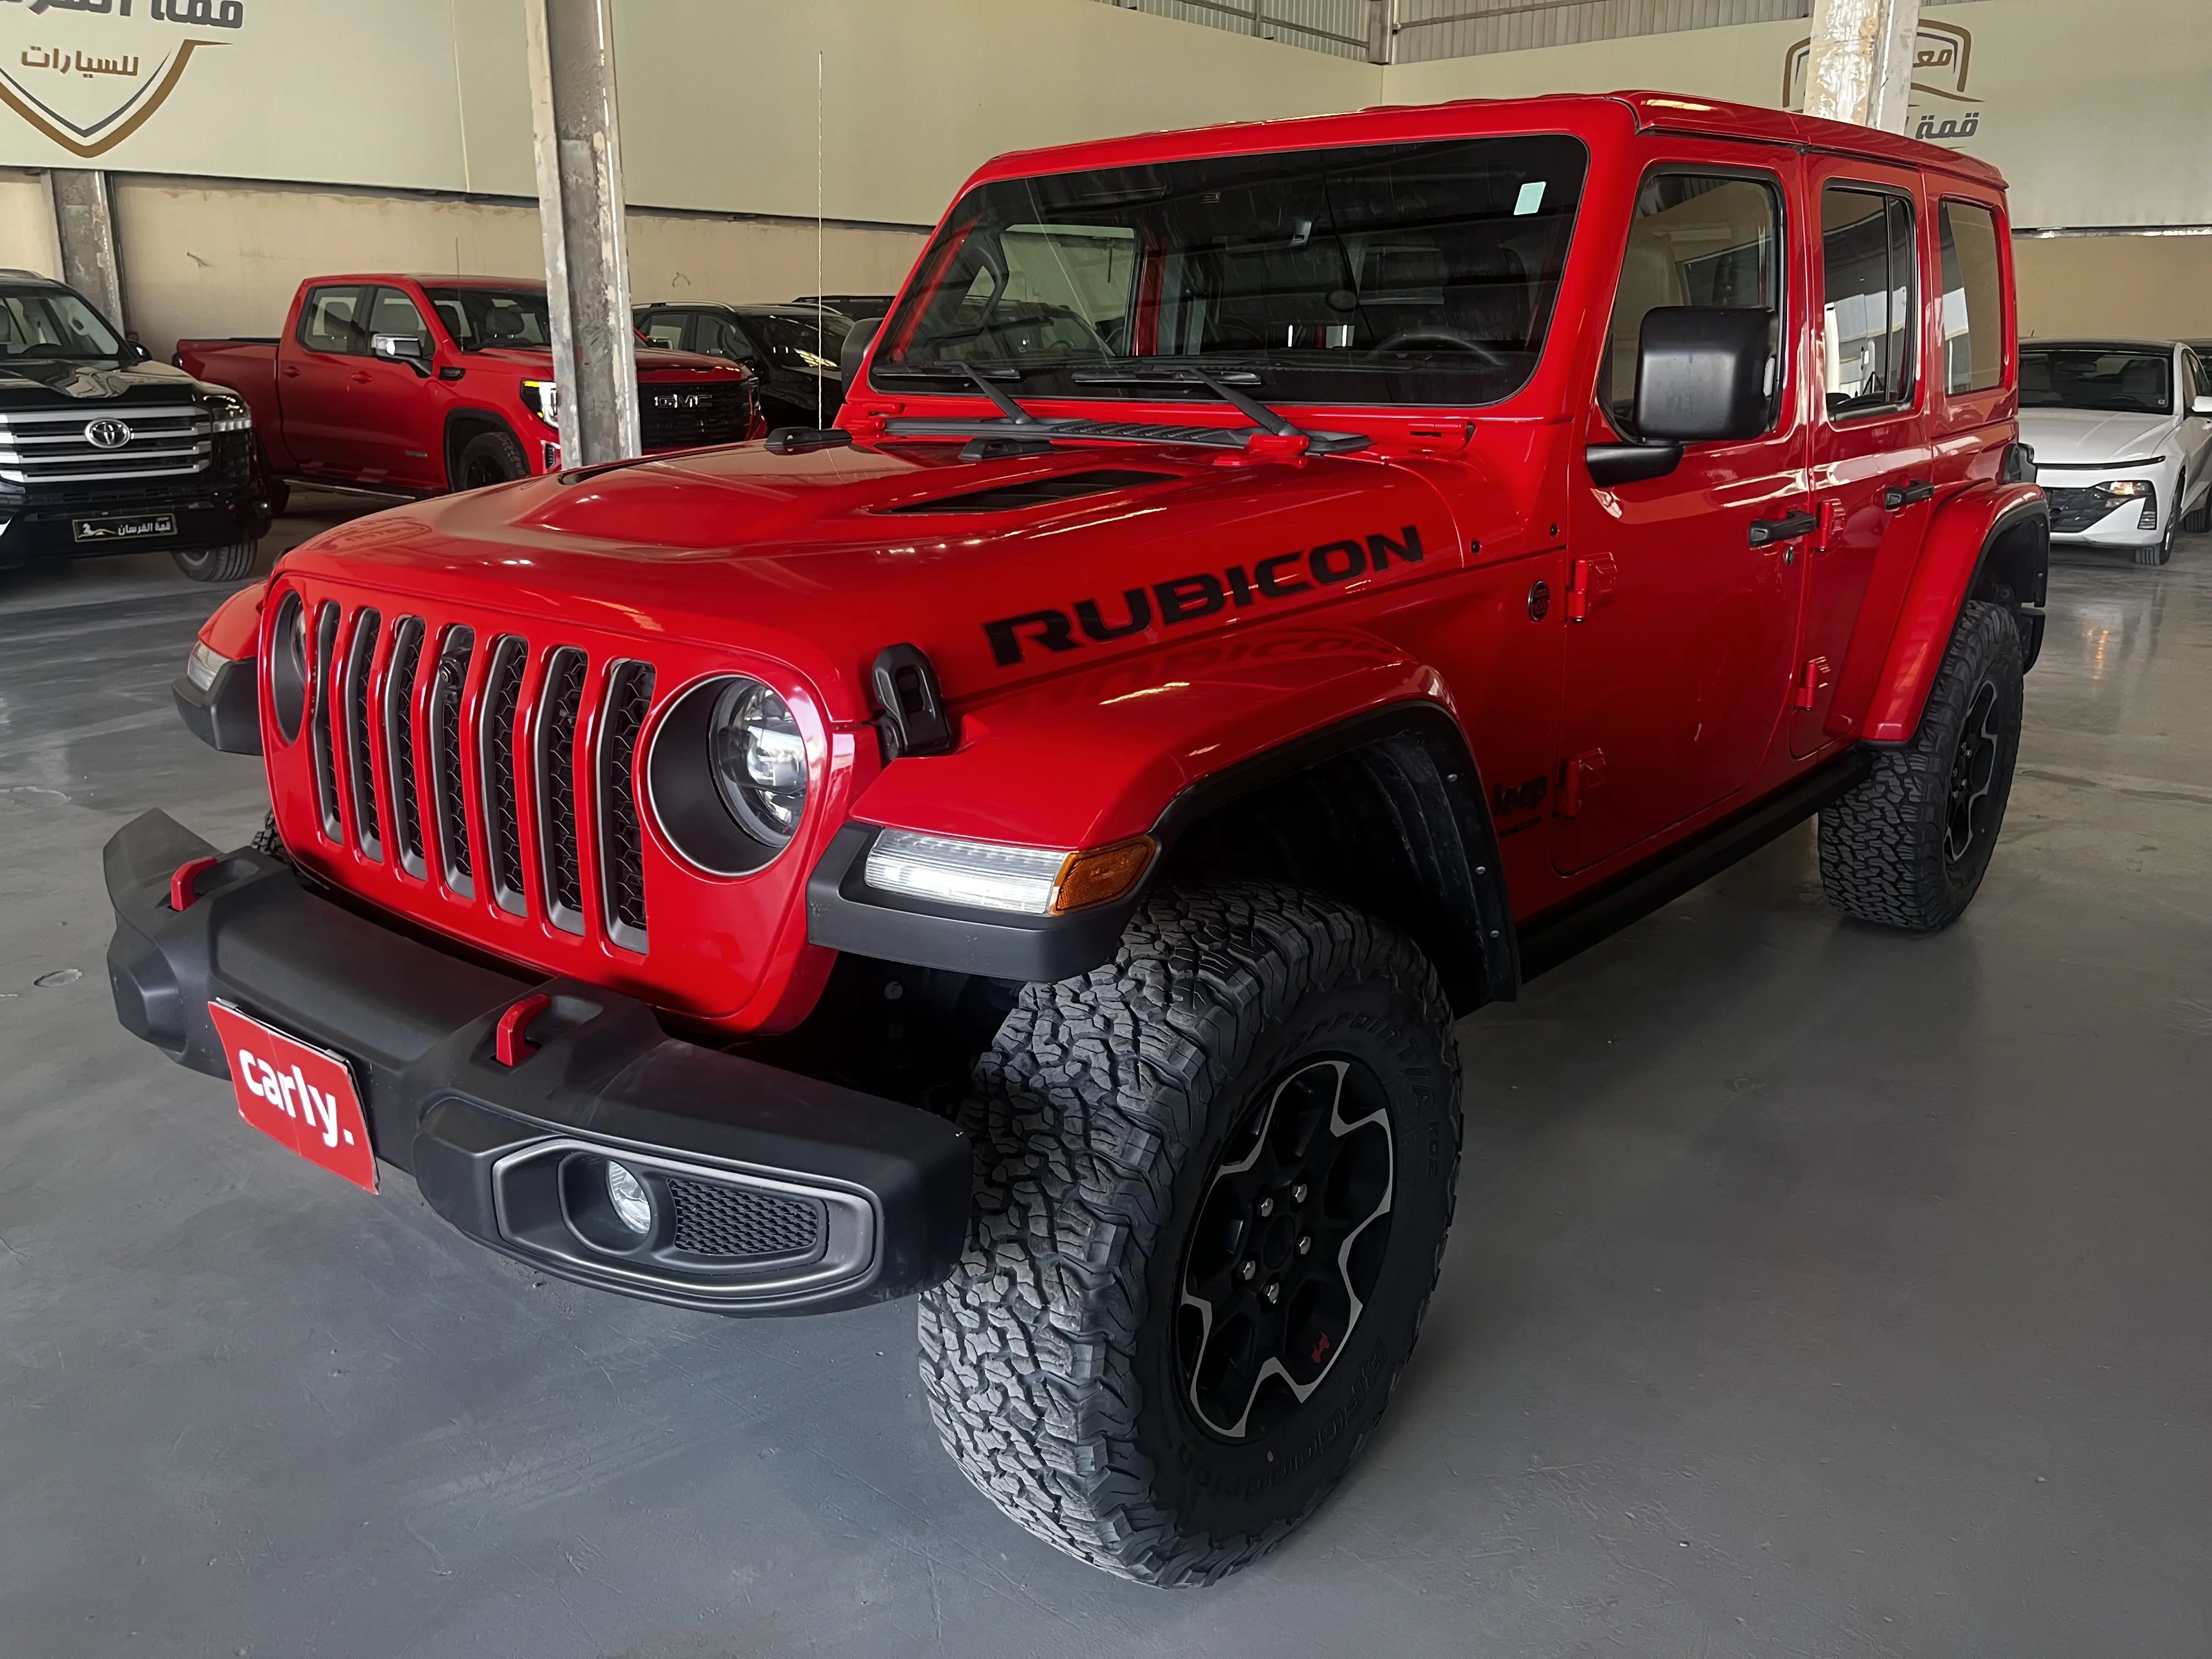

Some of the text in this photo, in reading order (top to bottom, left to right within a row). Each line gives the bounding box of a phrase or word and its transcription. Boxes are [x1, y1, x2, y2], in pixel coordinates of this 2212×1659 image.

[21, 46, 139, 78] للسيارات
[1915, 112, 1979, 139] قمة
[654, 393, 713, 408] GMC
[117, 522, 153, 536] الفرسان
[984, 525, 1424, 668] RUBICON
[238, 1049, 354, 1148] carly.
